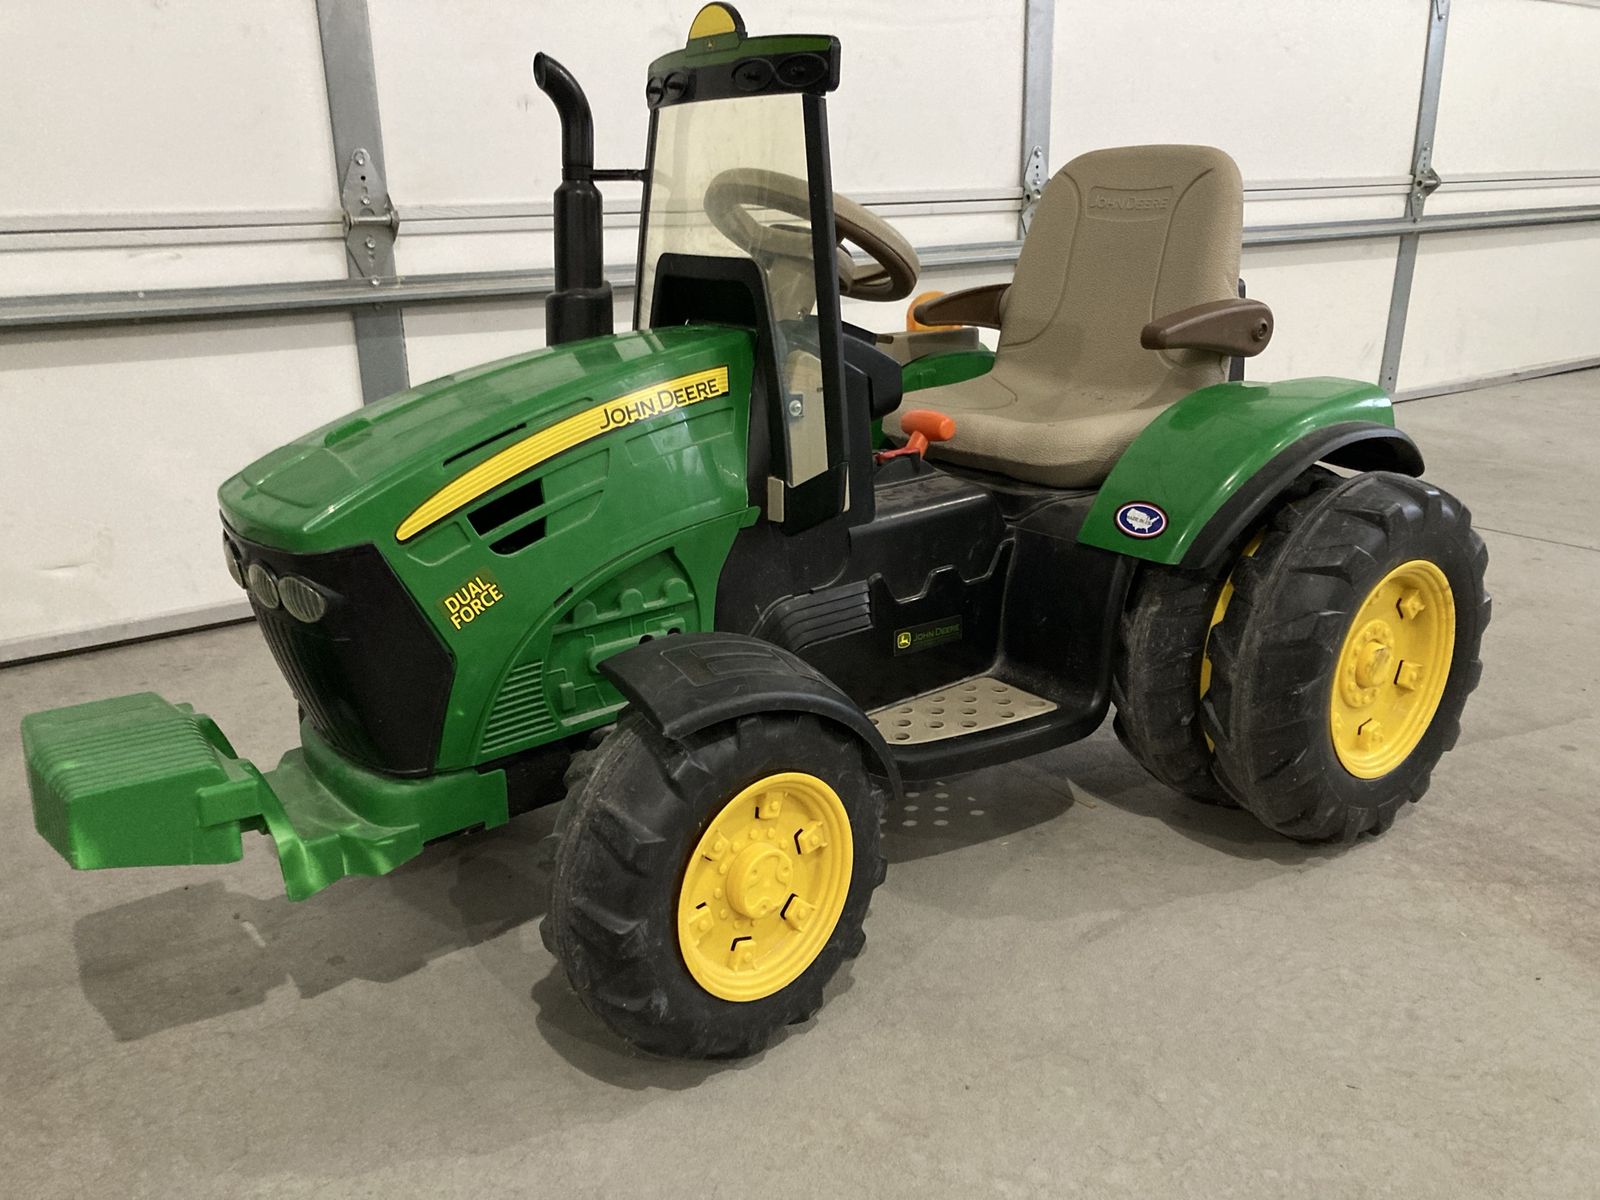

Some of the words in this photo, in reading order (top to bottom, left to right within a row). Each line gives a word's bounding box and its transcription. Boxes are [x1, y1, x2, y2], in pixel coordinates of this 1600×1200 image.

[1088, 195, 1123, 209] JOHN
[599, 399, 656, 430] JOHN
[656, 378, 720, 411] DEERE
[444, 576, 491, 614] DUAL
[450, 584, 504, 631] FORCE
[913, 630, 935, 642] JOHN
